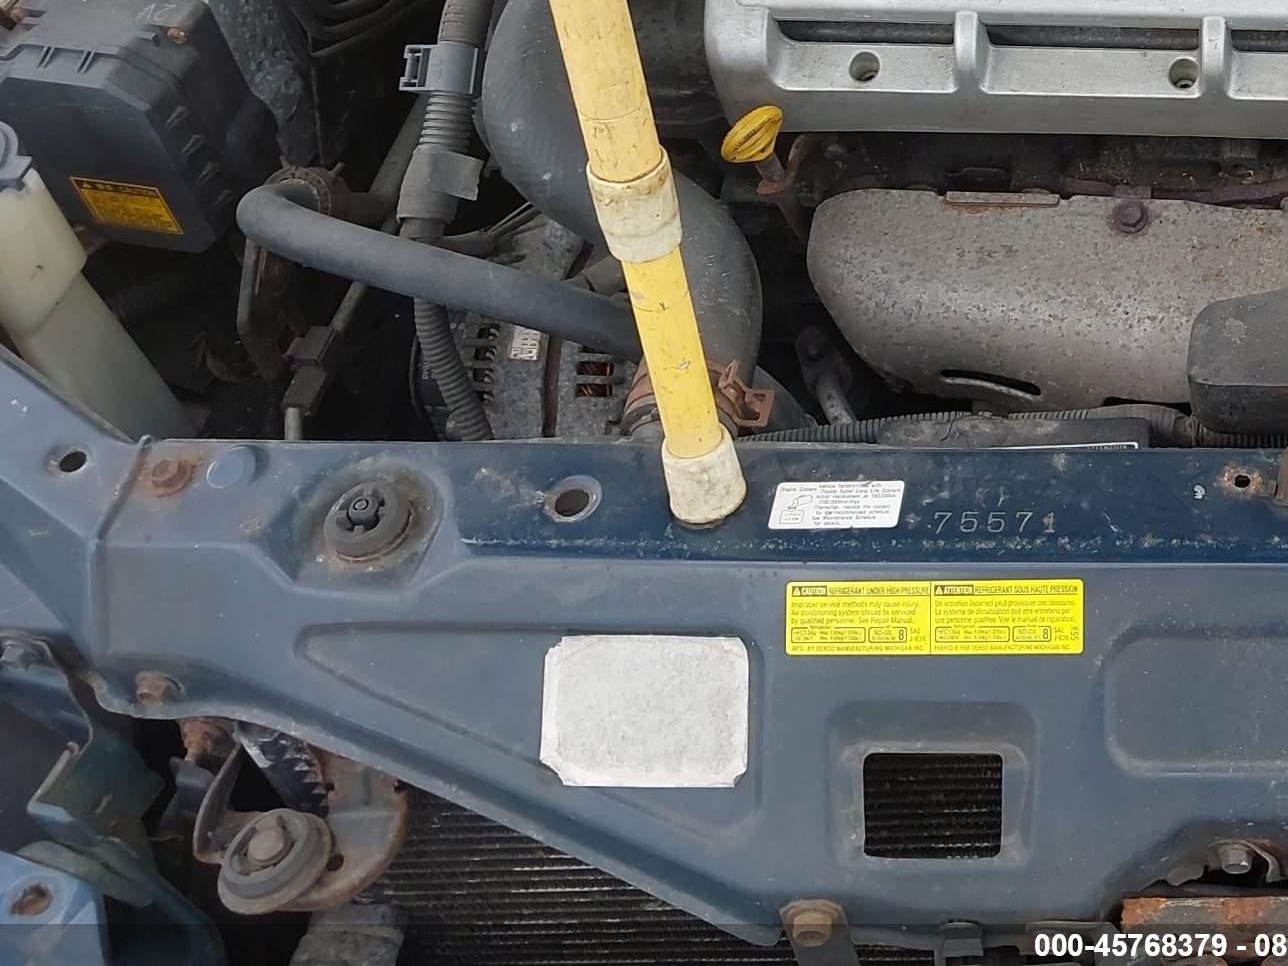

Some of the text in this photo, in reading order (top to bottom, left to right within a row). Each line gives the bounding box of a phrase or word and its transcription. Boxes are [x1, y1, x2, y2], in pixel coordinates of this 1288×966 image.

[801, 586, 929, 596] CAUTION REFRIGERANT UNDER HIGH PRESSURE
[944, 585, 973, 595] ATTENTION
[1014, 585, 1030, 594] SOUS
[1030, 585, 1049, 594] HAUTE
[1050, 585, 1078, 593] PRESSION
[898, 628, 905, 641] 8
[1042, 627, 1049, 640] 8
